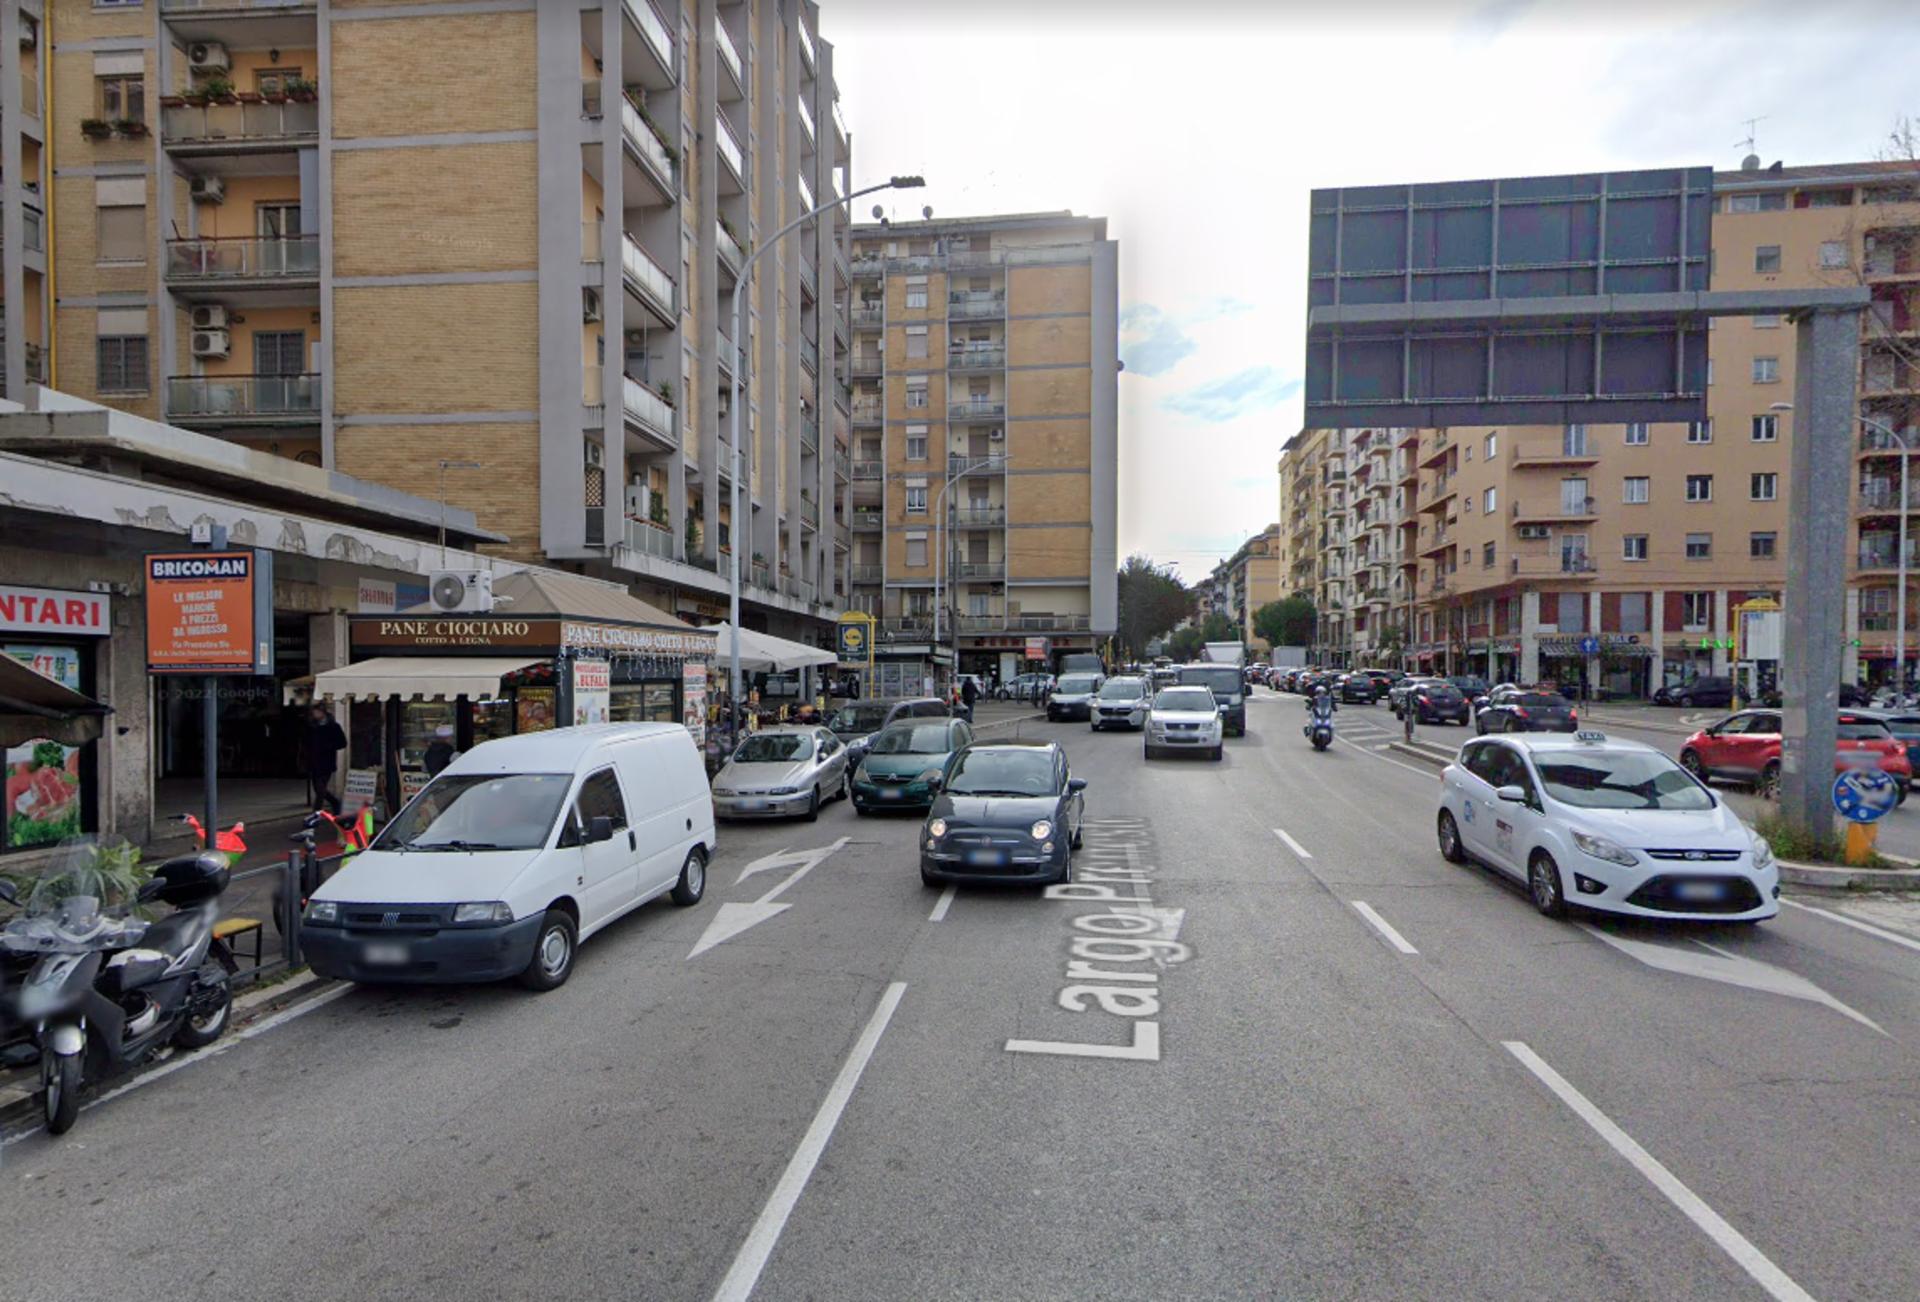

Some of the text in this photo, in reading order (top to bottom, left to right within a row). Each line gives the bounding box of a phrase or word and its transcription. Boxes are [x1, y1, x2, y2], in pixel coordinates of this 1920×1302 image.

[153, 560, 246, 576] BRICOMAN
[0, 595, 100, 626] NTARI
[380, 622, 529, 636] PANE CIOCIARO
[567, 625, 600, 644] PANE
[415, 637, 492, 645] COTTO A LEGNA
